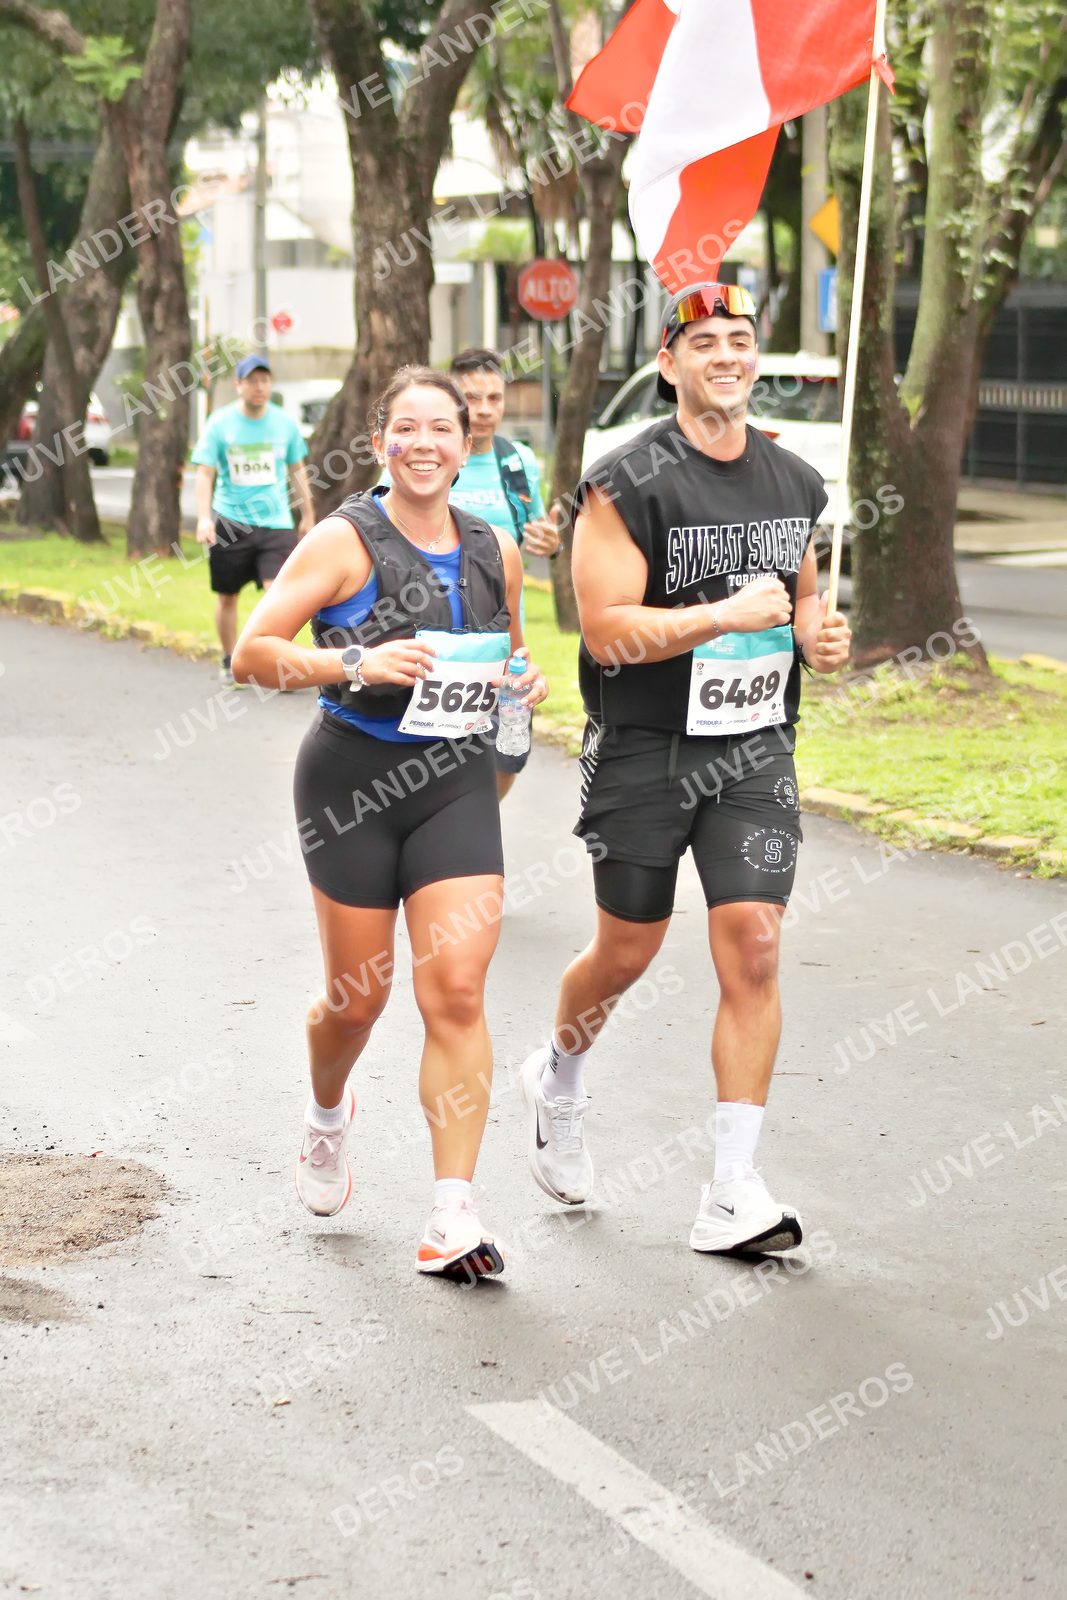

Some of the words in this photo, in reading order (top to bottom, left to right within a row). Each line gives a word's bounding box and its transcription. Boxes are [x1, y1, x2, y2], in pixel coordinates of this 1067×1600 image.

[523, 276, 577, 302] ALTO
[665, 523, 744, 595] SWEAT
[416, 679, 496, 713] 5625
[699, 670, 780, 710] 6489
[741, 828, 766, 853] SWEAT
[764, 838, 782, 863] S
